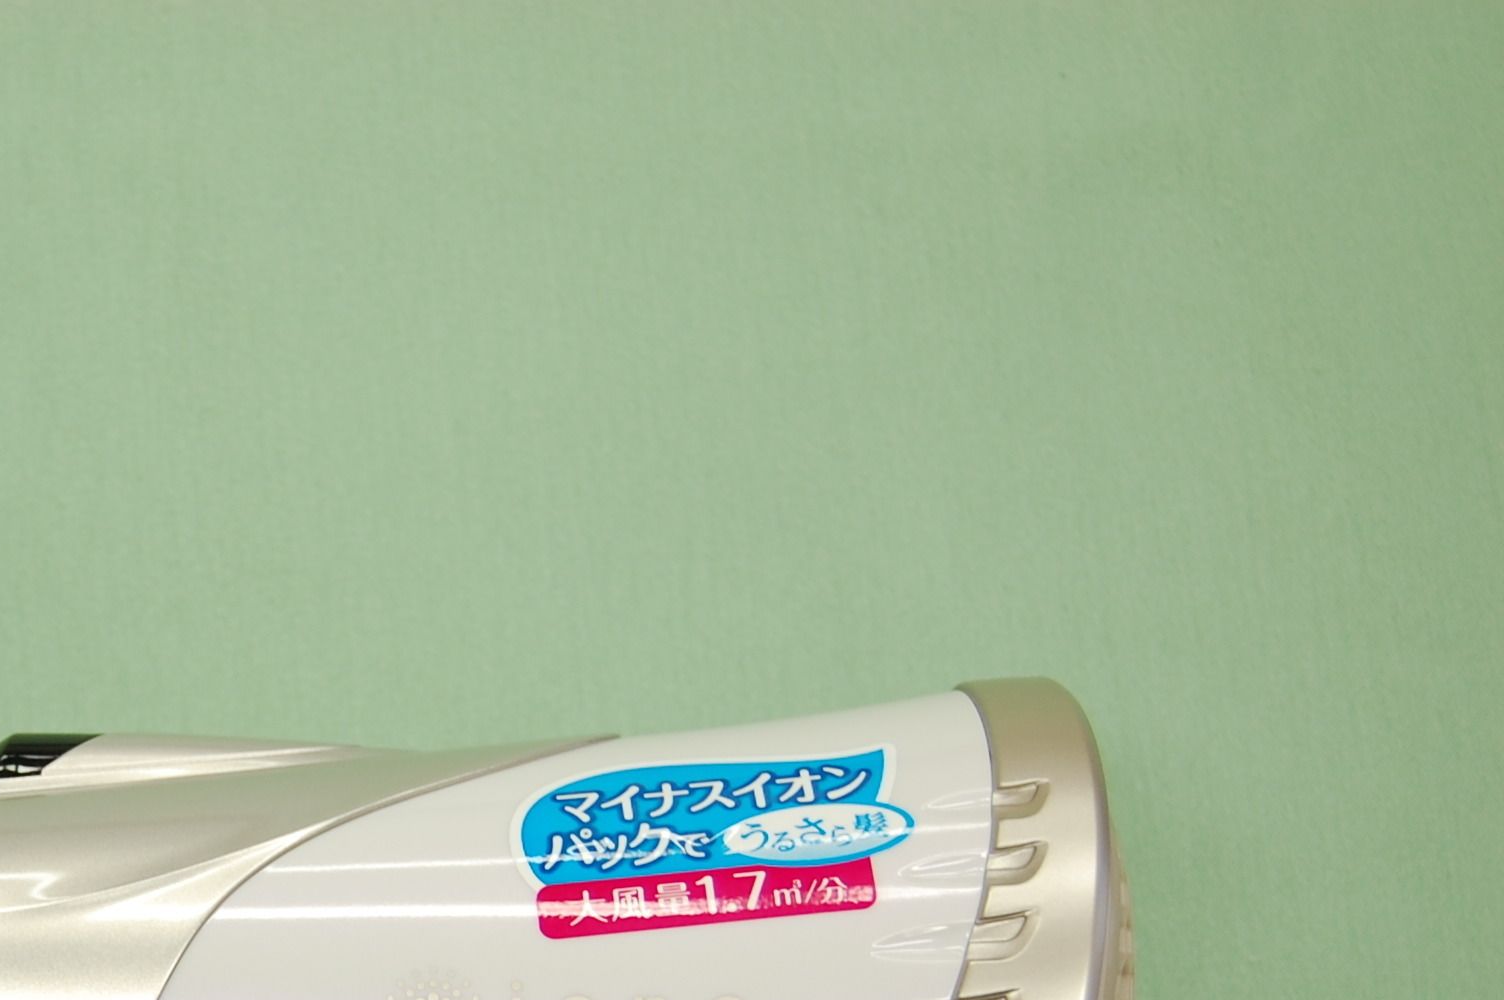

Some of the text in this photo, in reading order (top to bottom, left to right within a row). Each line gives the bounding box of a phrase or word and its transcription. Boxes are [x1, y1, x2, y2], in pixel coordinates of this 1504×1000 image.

[555, 766, 868, 823] マイナスイオン
[543, 822, 712, 871] パックで
